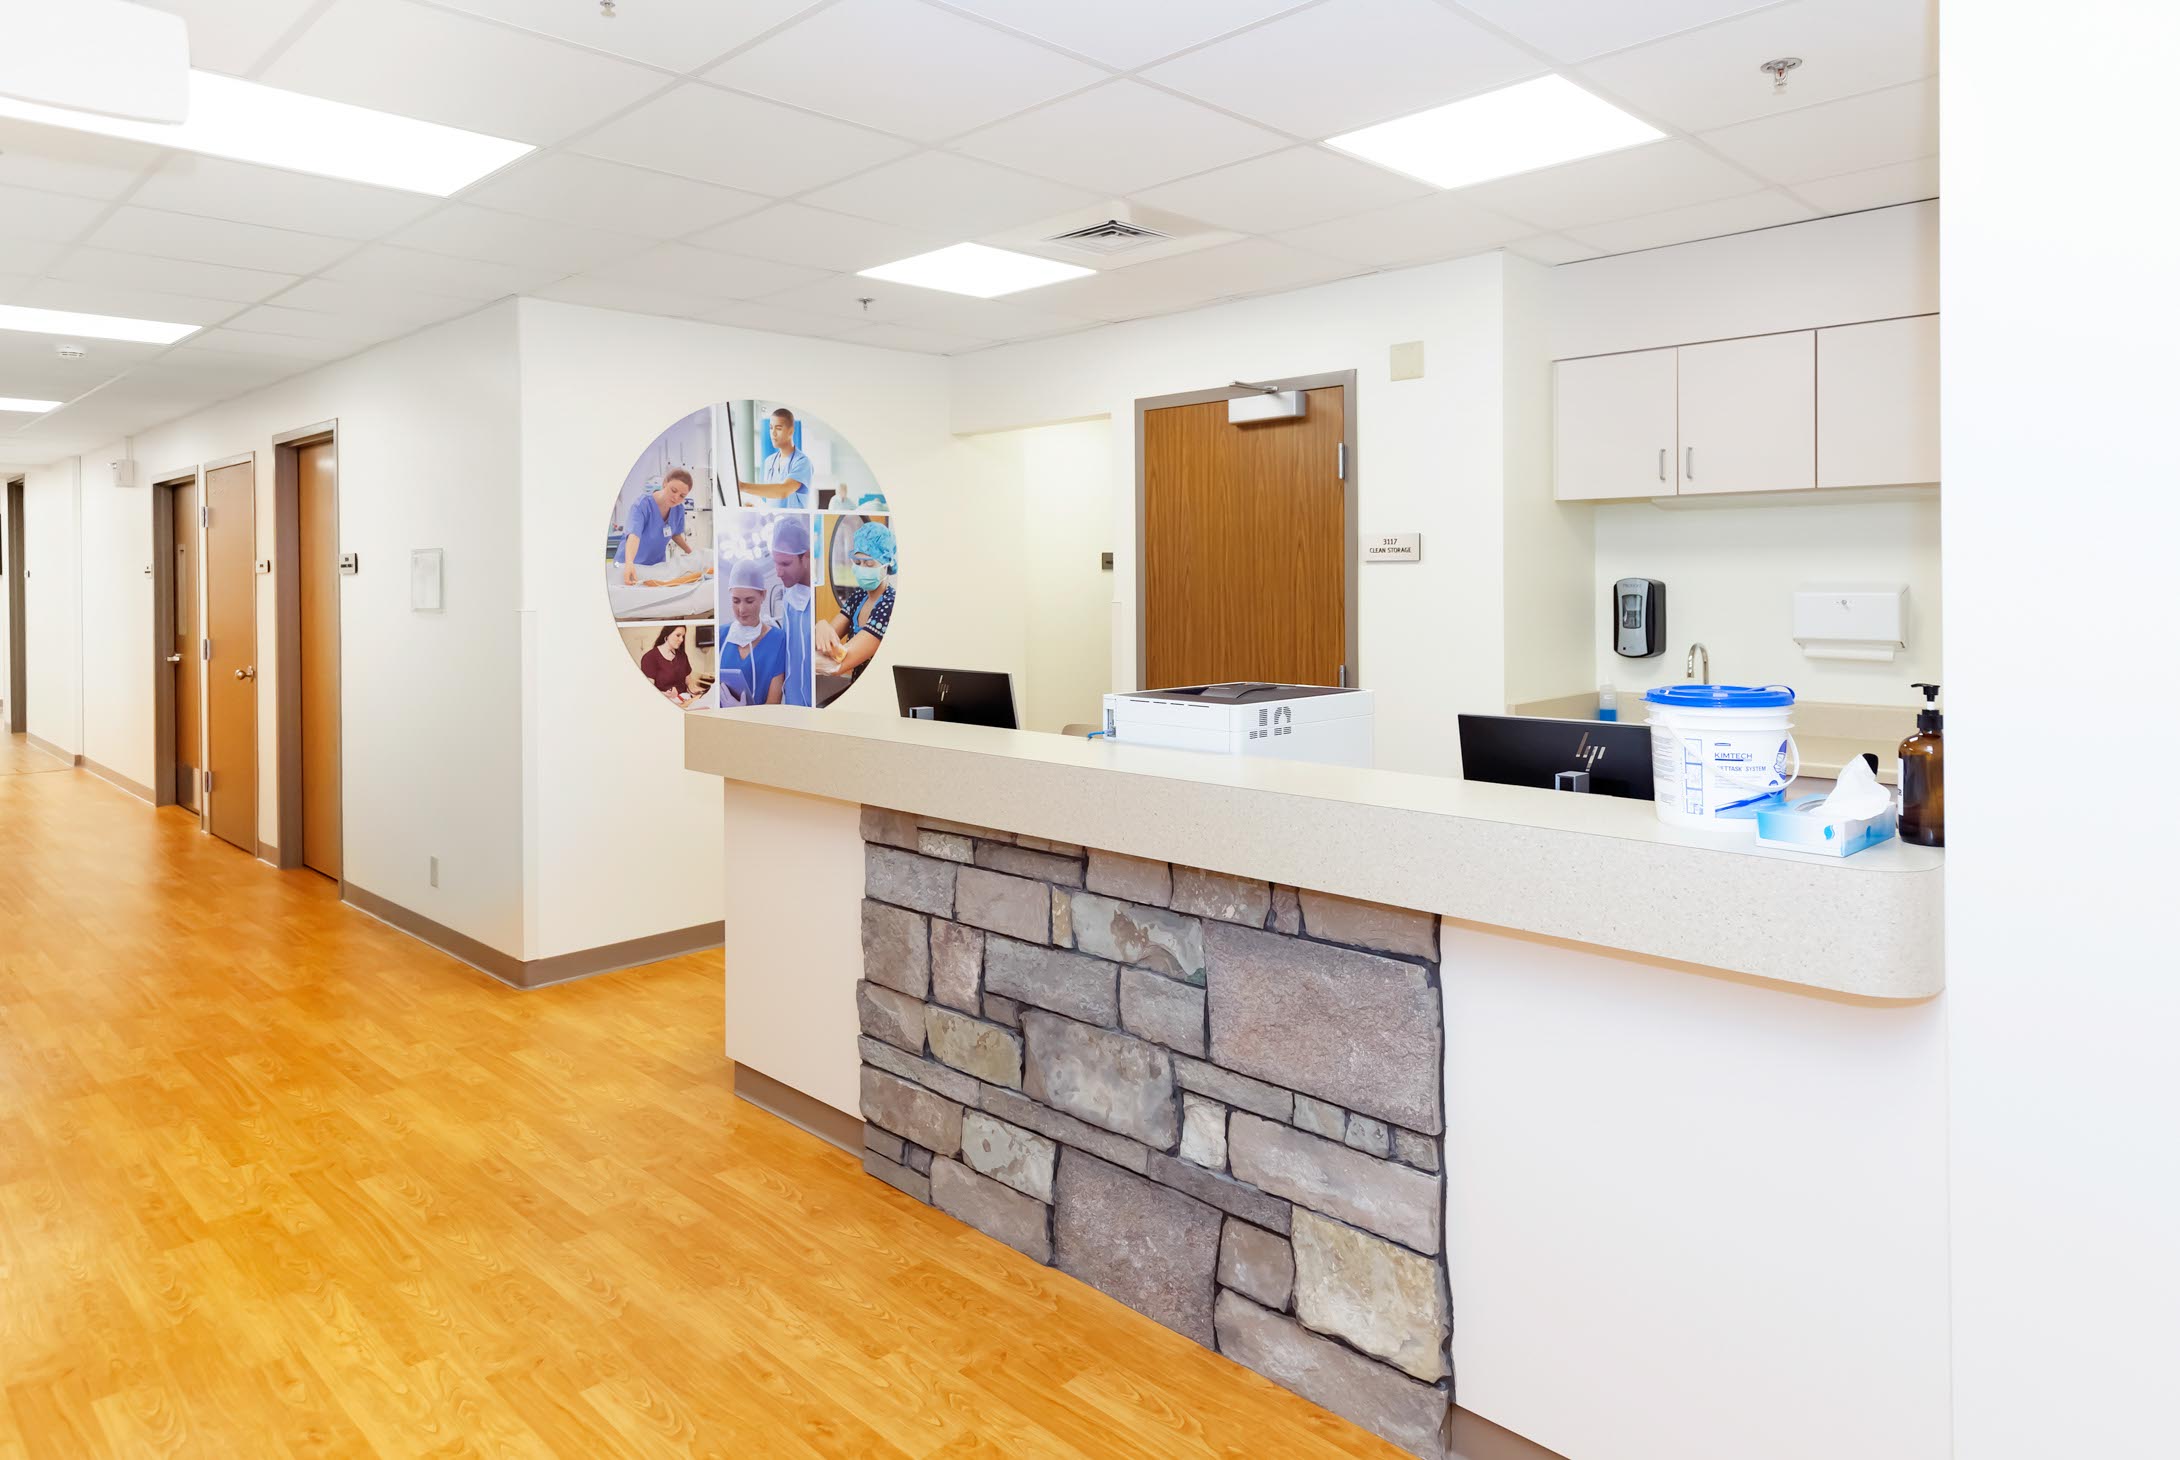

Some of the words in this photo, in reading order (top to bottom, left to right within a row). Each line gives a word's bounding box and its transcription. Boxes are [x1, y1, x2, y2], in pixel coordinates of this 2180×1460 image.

[1387, 546, 1412, 554] STORAGE
[1575, 731, 1606, 772] hp
[1714, 752, 1753, 760] KIMTECH
